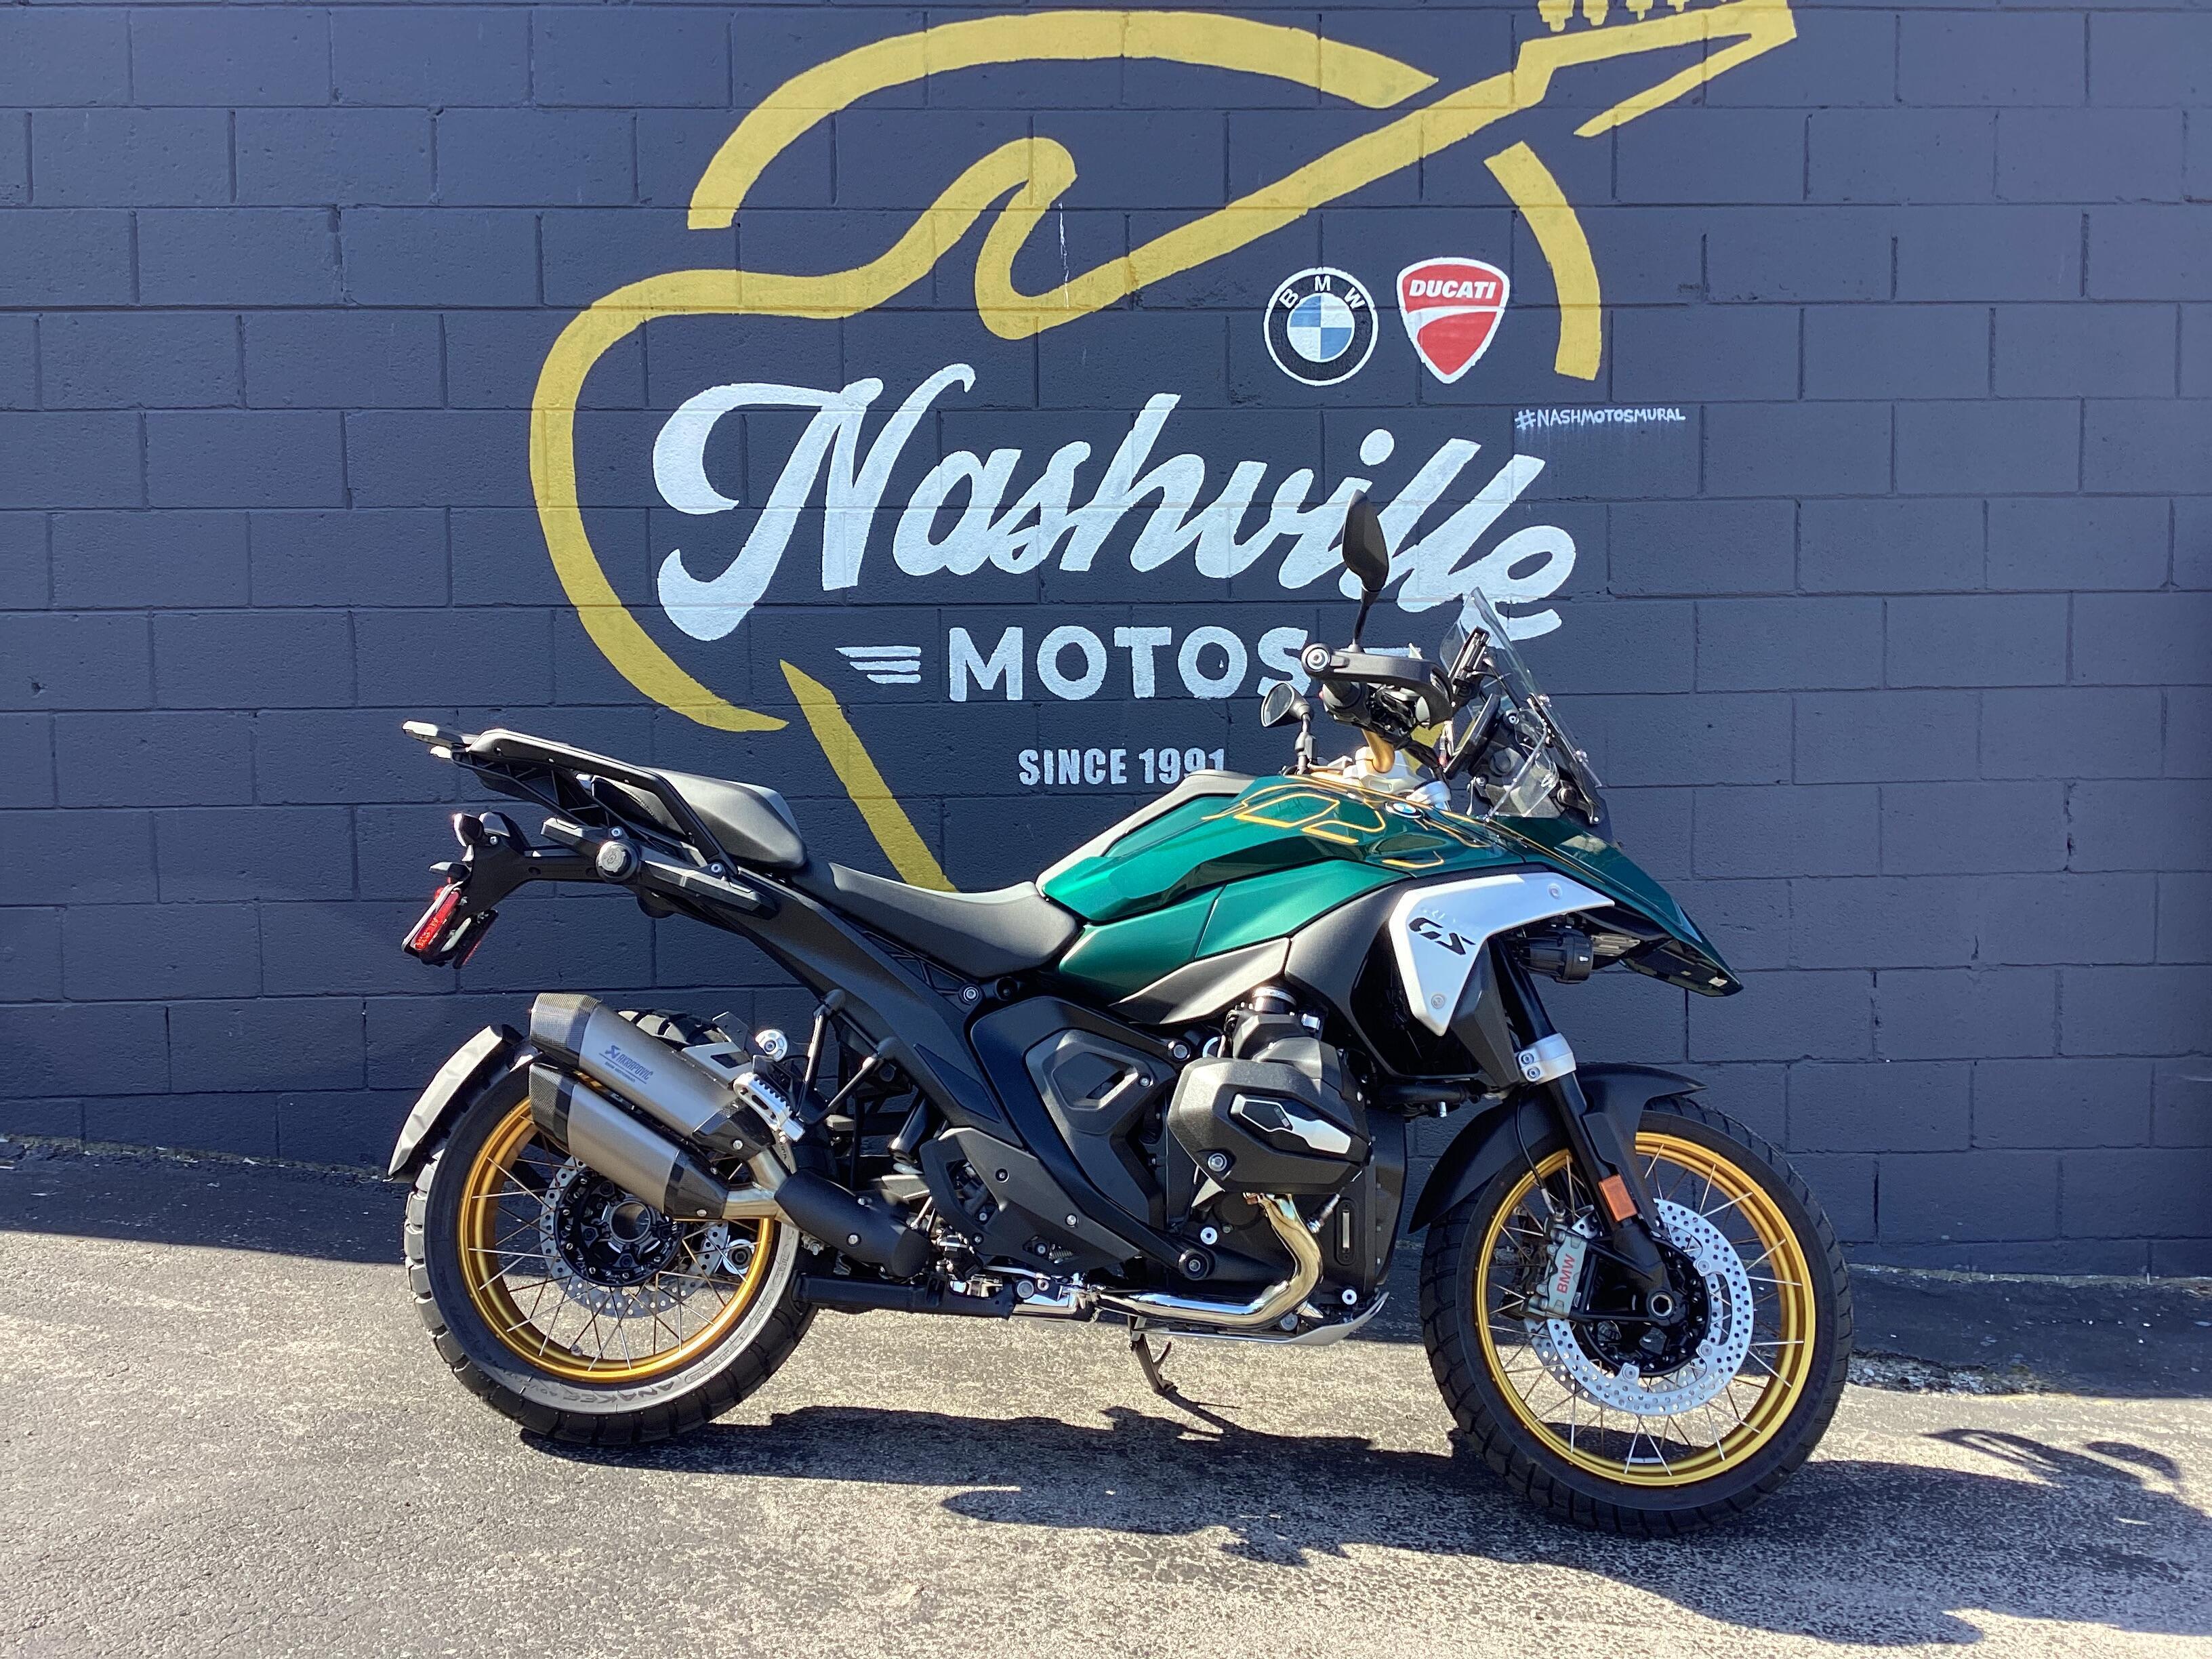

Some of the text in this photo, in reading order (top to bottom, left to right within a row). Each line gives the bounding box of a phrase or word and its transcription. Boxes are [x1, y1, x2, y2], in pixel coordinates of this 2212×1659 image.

[1279, 275, 1366, 309] BMW
[1409, 279, 1497, 300] DUCATI
[1515, 407, 1686, 430] #NASHMOTOSMURAL
[652, 363, 1576, 649] Nashville
[949, 625, 1311, 702] MOTOS
[1018, 747, 1127, 785] SINCE
[1408, 917, 1476, 955] GS
[1556, 1253, 1576, 1294] BMW
